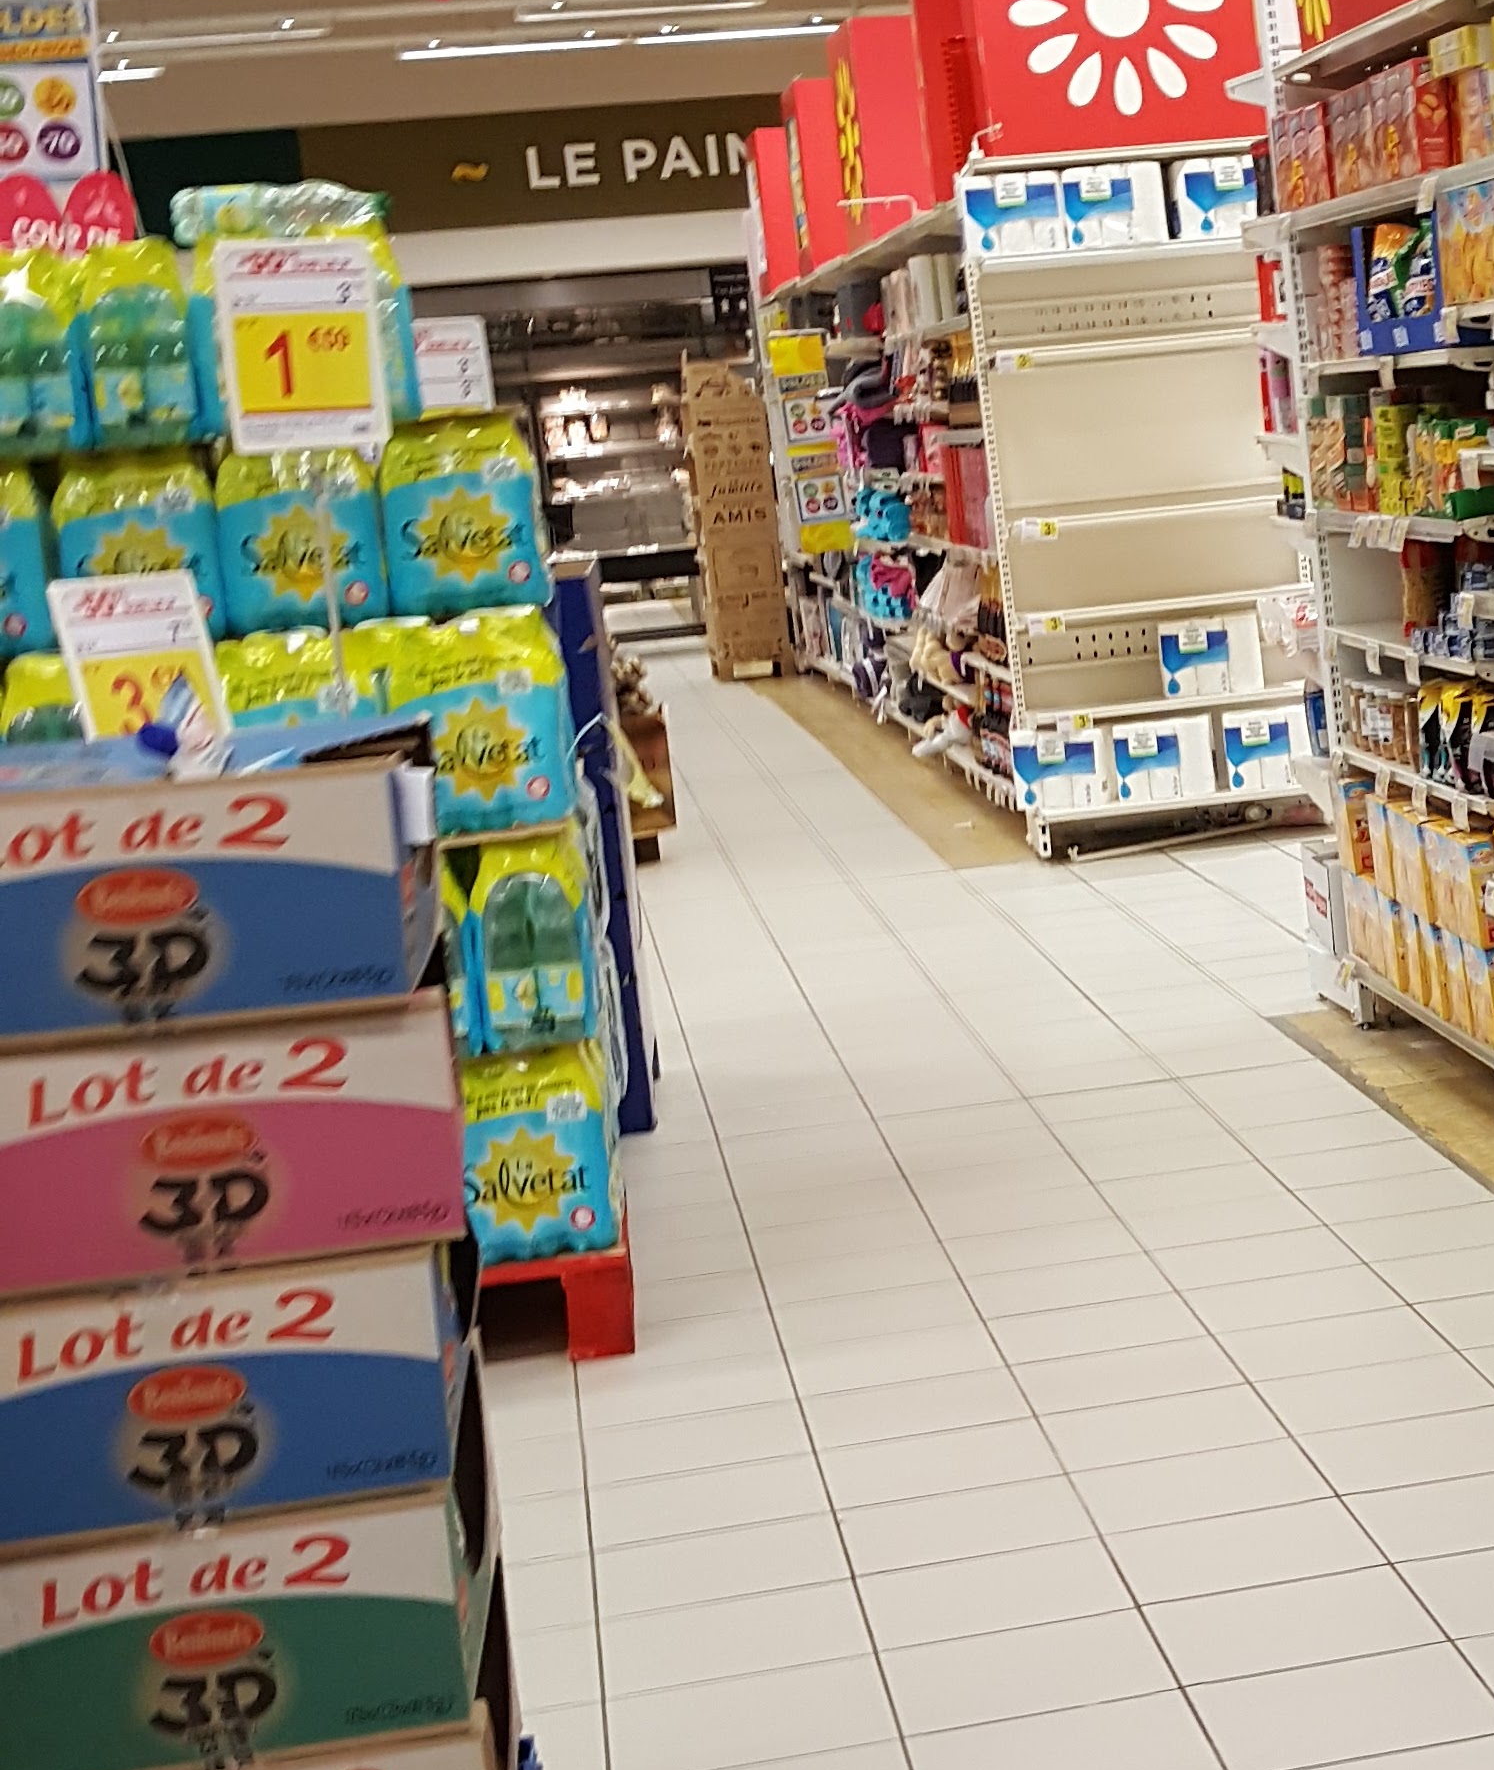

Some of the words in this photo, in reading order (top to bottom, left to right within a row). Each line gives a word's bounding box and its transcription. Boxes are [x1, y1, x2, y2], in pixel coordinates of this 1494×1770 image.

[525, 142, 601, 190] LE
[621, 132, 749, 184] PAIN
[435, 723, 543, 778] alvetat
[0, 812, 95, 869] ot
[120, 810, 205, 853] de
[220, 794, 291, 851] 2
[74, 931, 210, 997] 3D
[27, 1059, 155, 1128] Lot
[182, 1055, 264, 1096] de
[279, 1036, 350, 1092] 2
[138, 1170, 269, 1237] 3D
[465, 1158, 588, 1206] Salvetat
[18, 1313, 143, 1379] Lot
[169, 1308, 253, 1350] de
[266, 1287, 336, 1344] 2
[127, 1424, 259, 1489] 3D
[41, 1559, 162, 1629] Lot
[188, 1553, 268, 1592] de
[283, 1533, 351, 1588] 2
[150, 1667, 277, 1731] 3D
